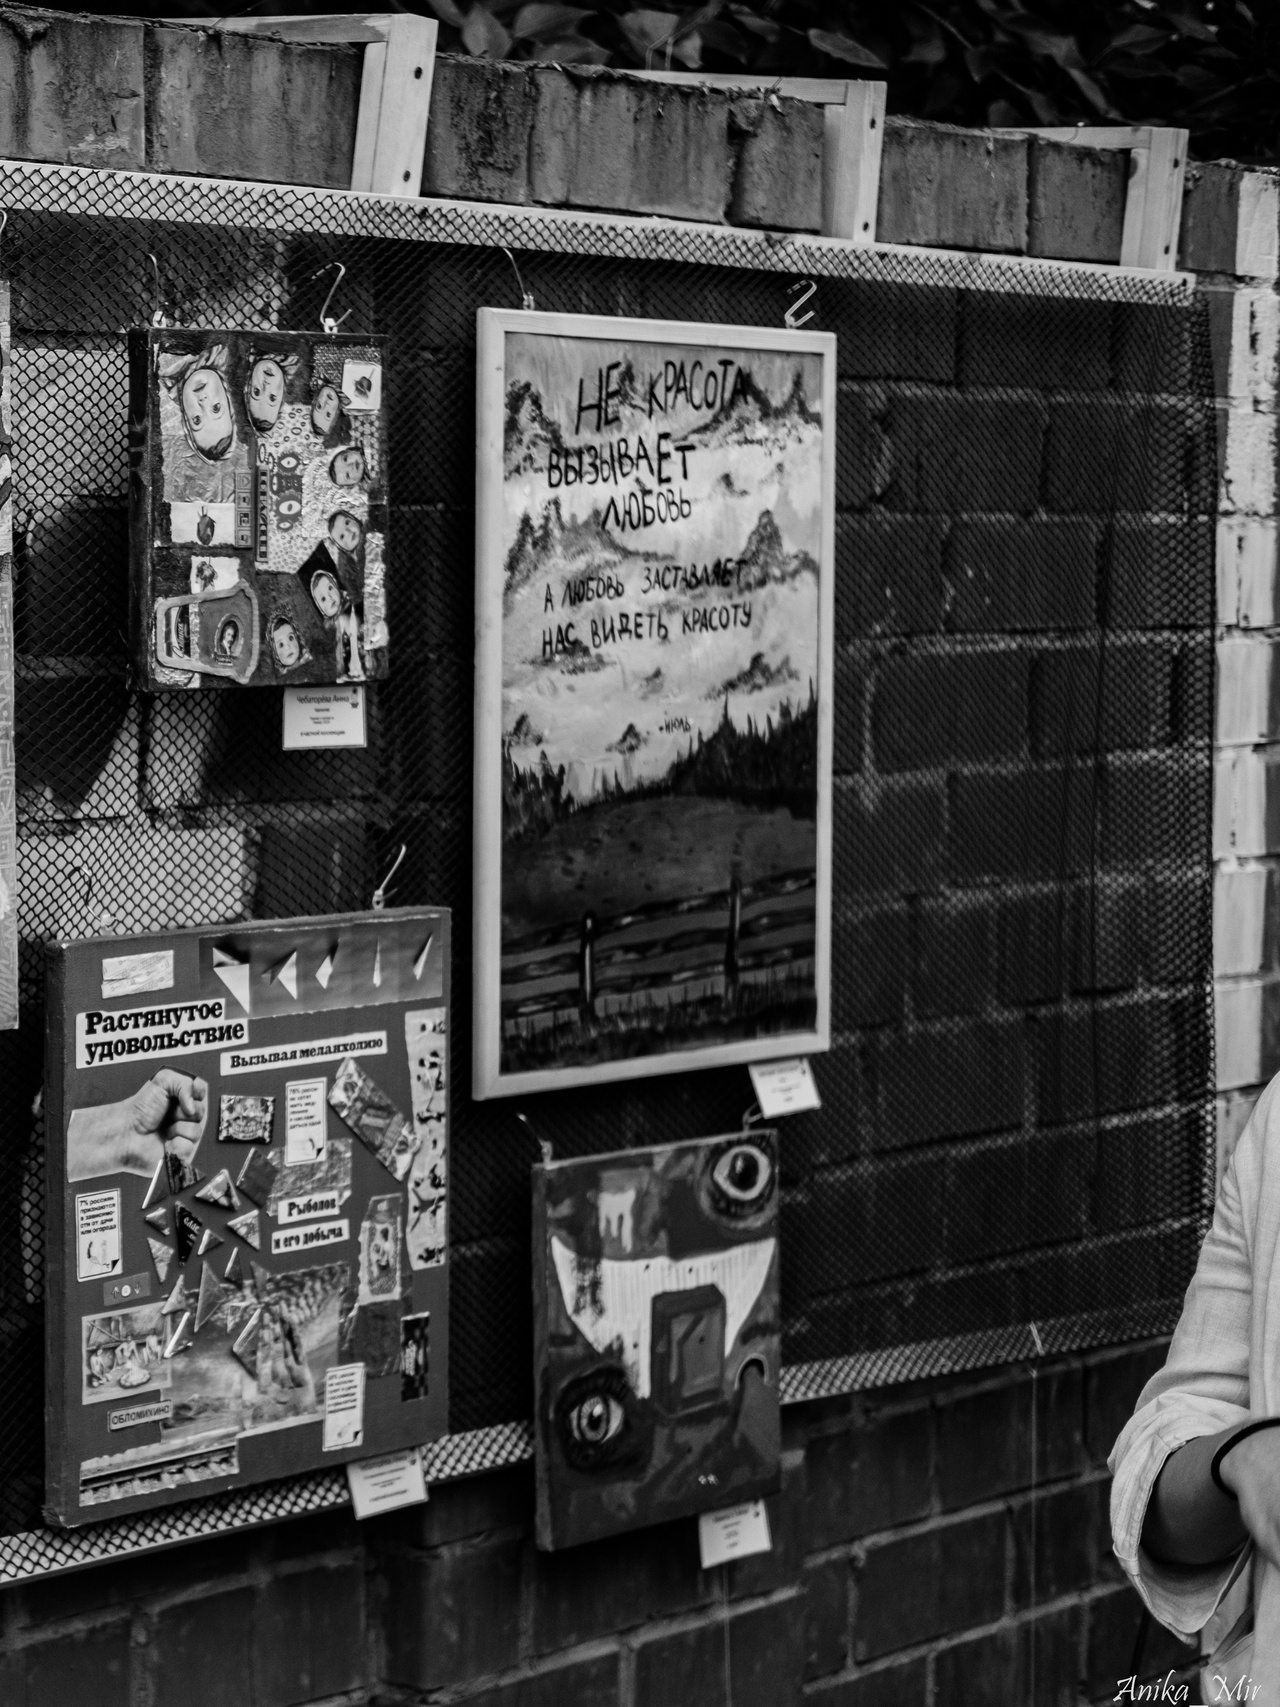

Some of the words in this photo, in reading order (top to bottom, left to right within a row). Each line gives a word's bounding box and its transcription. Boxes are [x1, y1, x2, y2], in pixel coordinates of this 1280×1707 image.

[575, 361, 623, 436] НЕ
[648, 358, 750, 420] КРАСОТА
[547, 432, 697, 489] ВЫЗЫВАЕТ
[601, 488, 692, 533] ЛЮБОВЬ
[543, 582, 554, 613] А
[561, 573, 625, 609] ЛЮБОВЬ
[542, 622, 577, 658] НАС
[590, 611, 670, 649] ВИДЕТЬ
[681, 602, 752, 636] КРАСОТУ
[84, 999, 224, 1036] Растянутое
[84, 1022, 246, 1065] удовольствие
[230, 1048, 297, 1069] Вызывая
[298, 1036, 384, 1061] меланхолию
[80, 1203, 116, 1213] признаются
[288, 1197, 336, 1217] Рыболов
[283, 1235, 300, 1248] его
[303, 1226, 343, 1246] добыча
